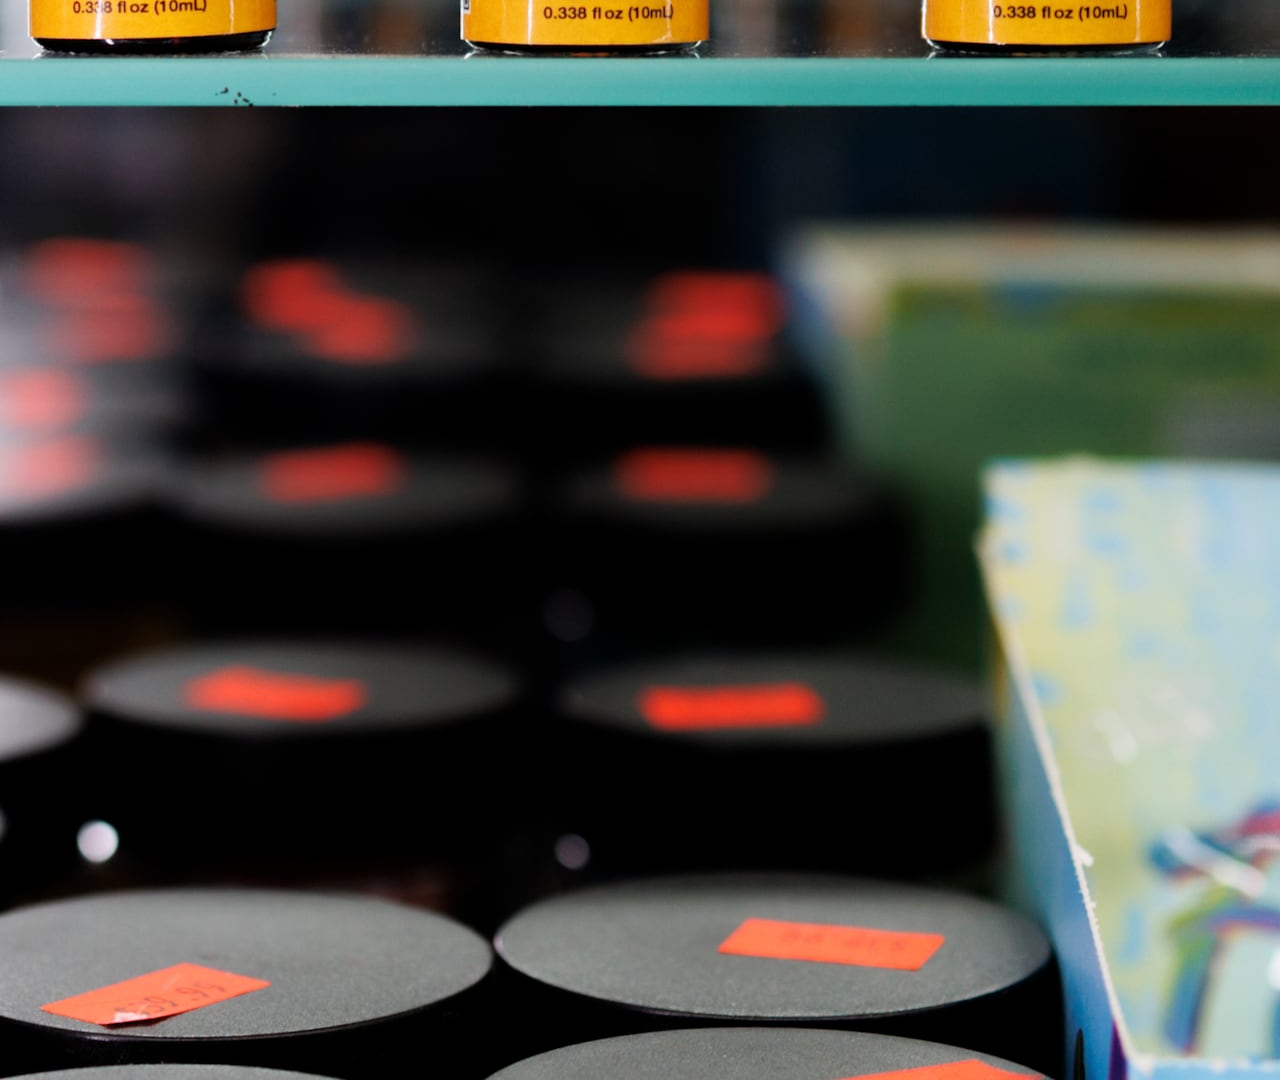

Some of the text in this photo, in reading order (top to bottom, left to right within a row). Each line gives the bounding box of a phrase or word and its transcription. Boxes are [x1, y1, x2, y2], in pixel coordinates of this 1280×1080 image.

[117, 0, 128, 13] fl
[130, 2, 148, 13] oz
[544, 6, 674, 22] 0.338 fl oz (10mL)
[993, 4, 1127, 21] 0.338 fl oz (10mL)
